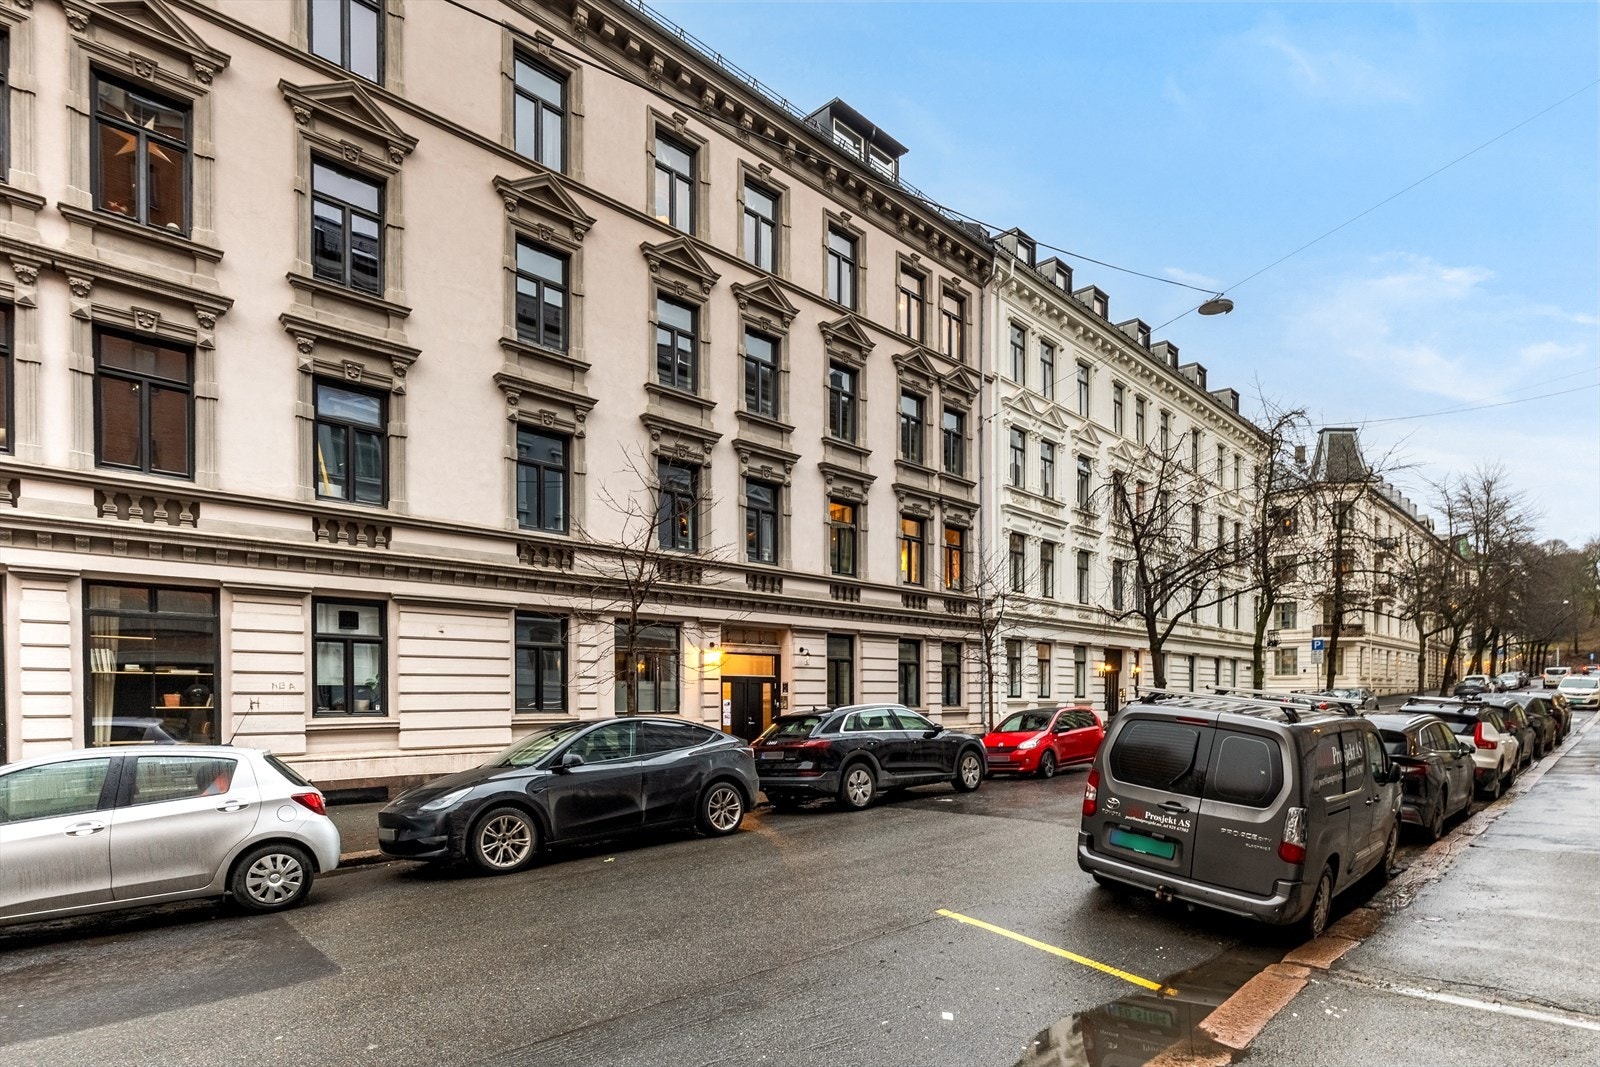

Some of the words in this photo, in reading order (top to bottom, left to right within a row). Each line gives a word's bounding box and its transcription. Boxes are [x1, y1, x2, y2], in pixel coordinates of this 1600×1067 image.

[1314, 640, 1321, 649] P
[1101, 807, 1121, 817] TOYOTA
[1145, 811, 1177, 825] Prosjekt
[1178, 819, 1191, 828] AS
